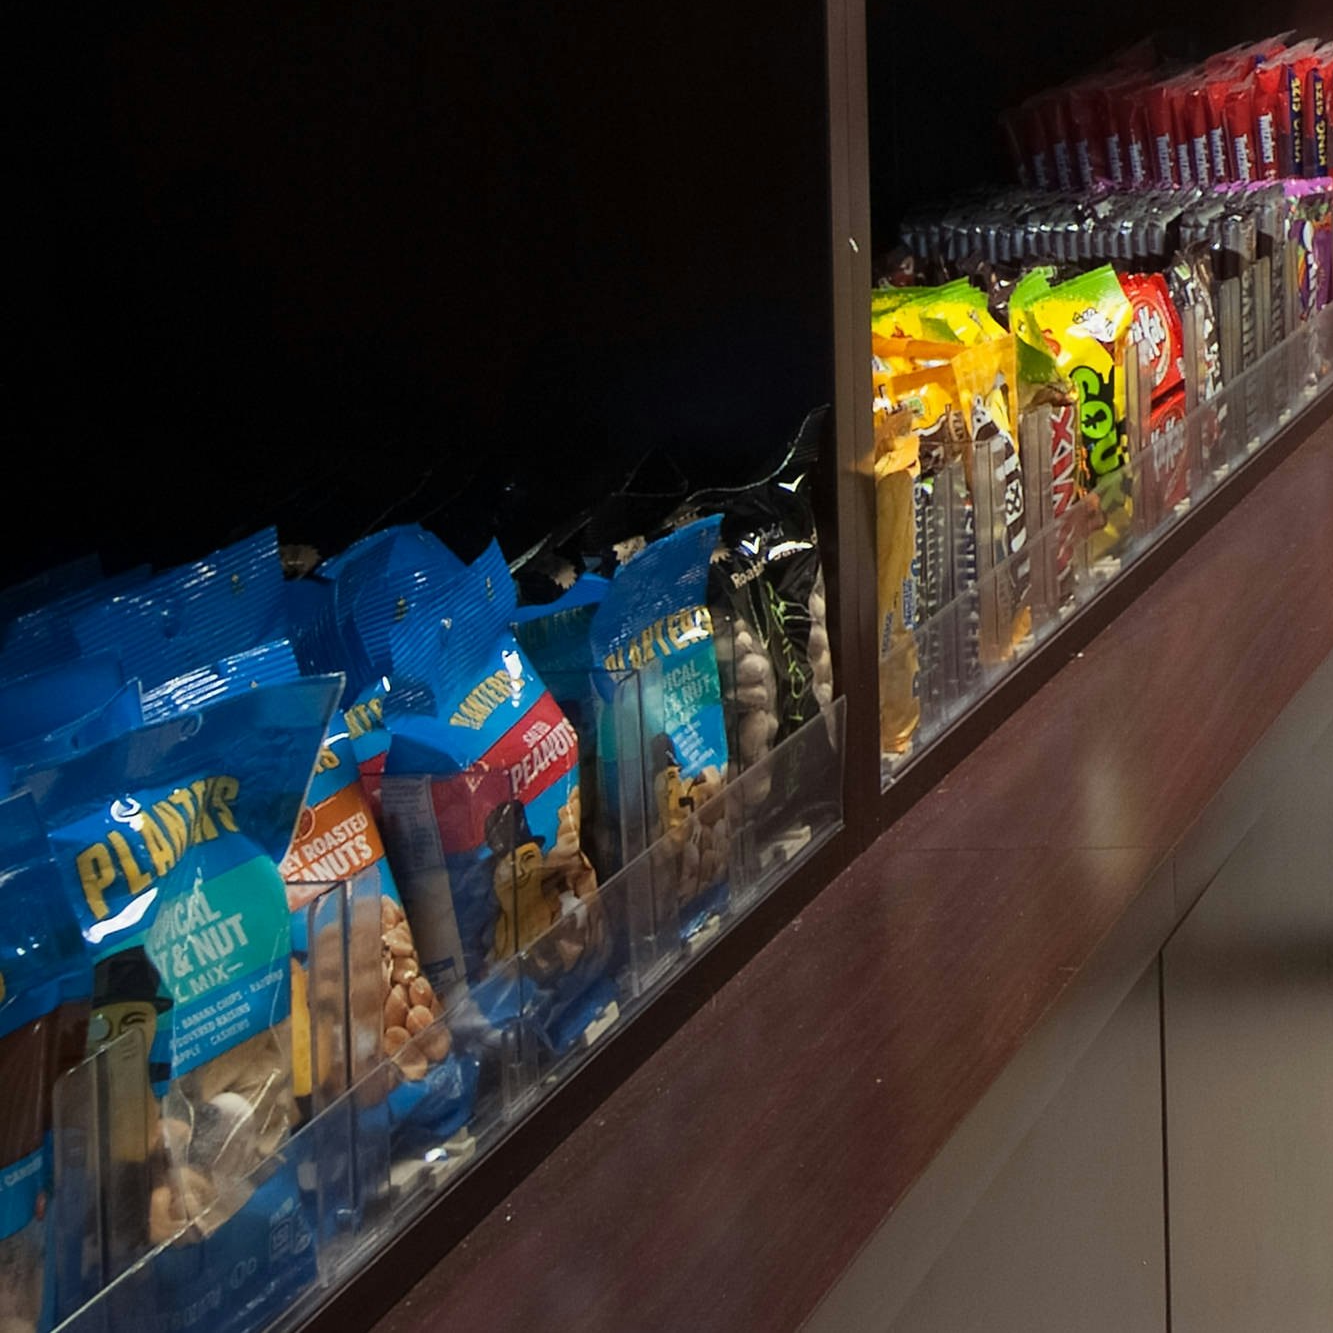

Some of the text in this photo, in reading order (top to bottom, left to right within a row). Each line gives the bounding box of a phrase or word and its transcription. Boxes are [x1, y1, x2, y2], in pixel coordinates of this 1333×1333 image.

[304, 810, 370, 865] ROASTED
[193, 911, 250, 968] NUT
[189, 963, 231, 997] MIX
